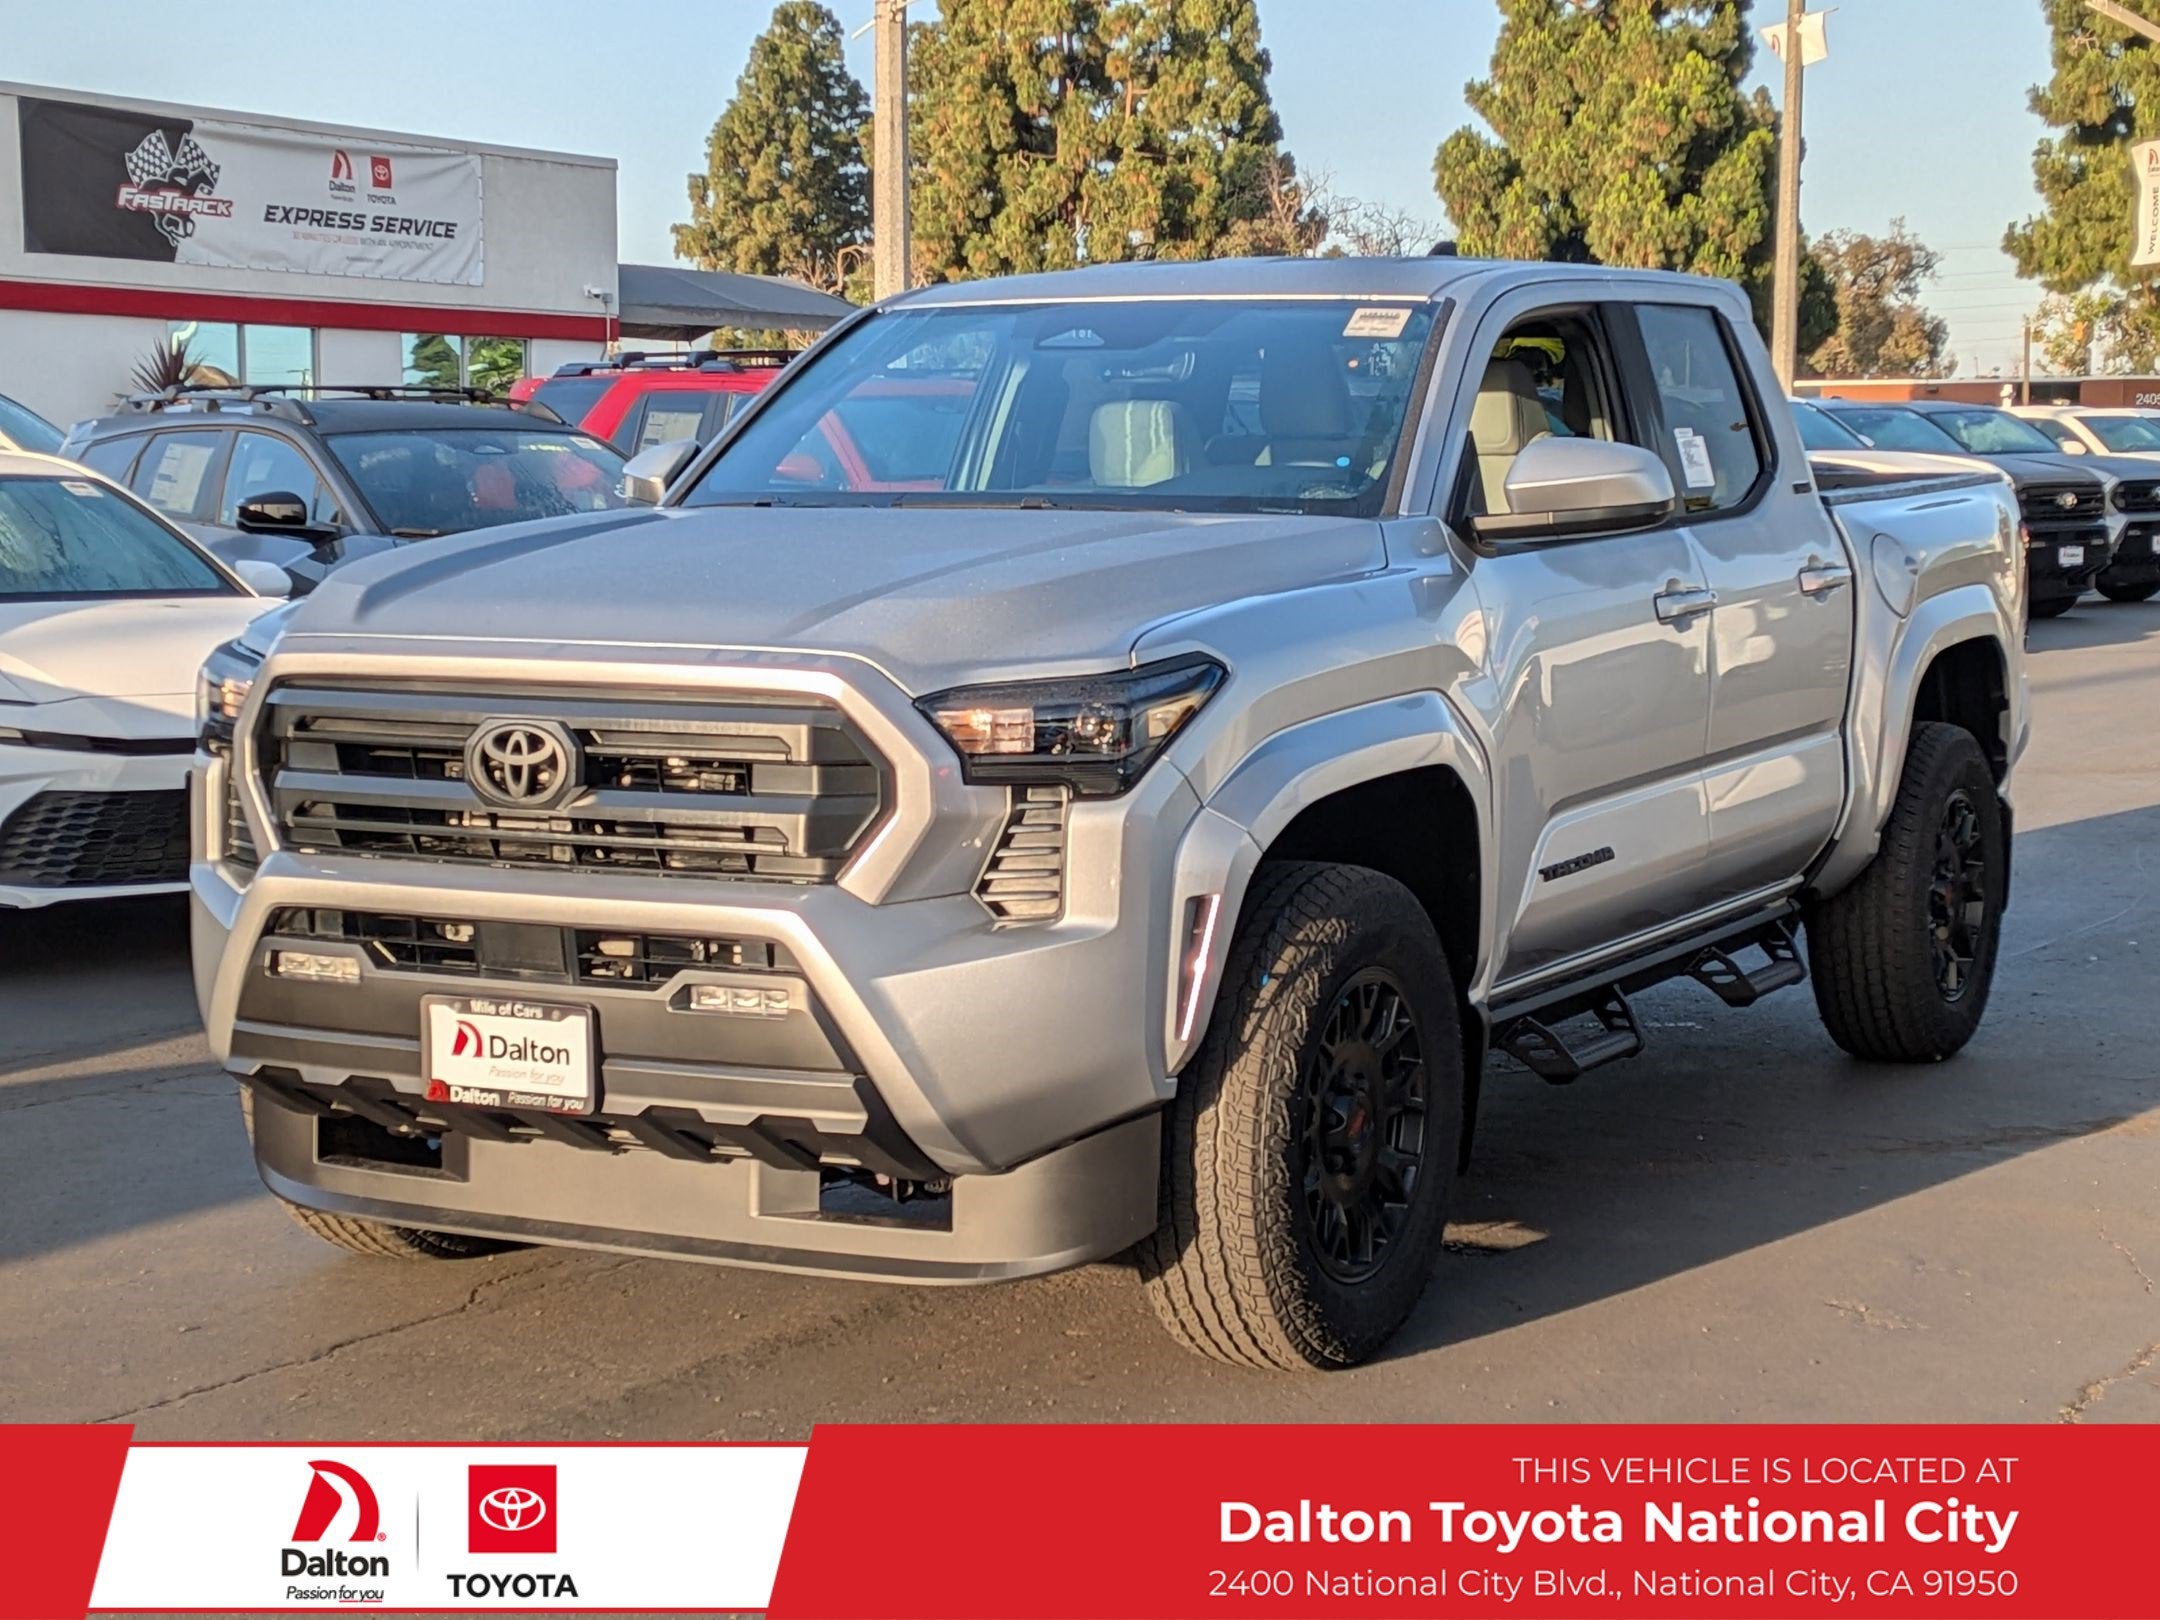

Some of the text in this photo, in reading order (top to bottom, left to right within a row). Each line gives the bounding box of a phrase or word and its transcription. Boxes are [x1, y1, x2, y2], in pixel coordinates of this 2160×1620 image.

[367, 193, 396, 206] TOYOTA
[263, 204, 367, 231] EXPRESS
[370, 216, 458, 239] SERVICE
[2148, 186, 2160, 255] WELCOME
[470, 1000, 544, 1019] Mile of Cars
[489, 1035, 570, 1066] Dalton
[490, 1066, 528, 1081] Passion
[529, 1068, 544, 1081] for
[450, 1086, 500, 1107] Dalton
[508, 1092, 584, 1111] Passion for you
